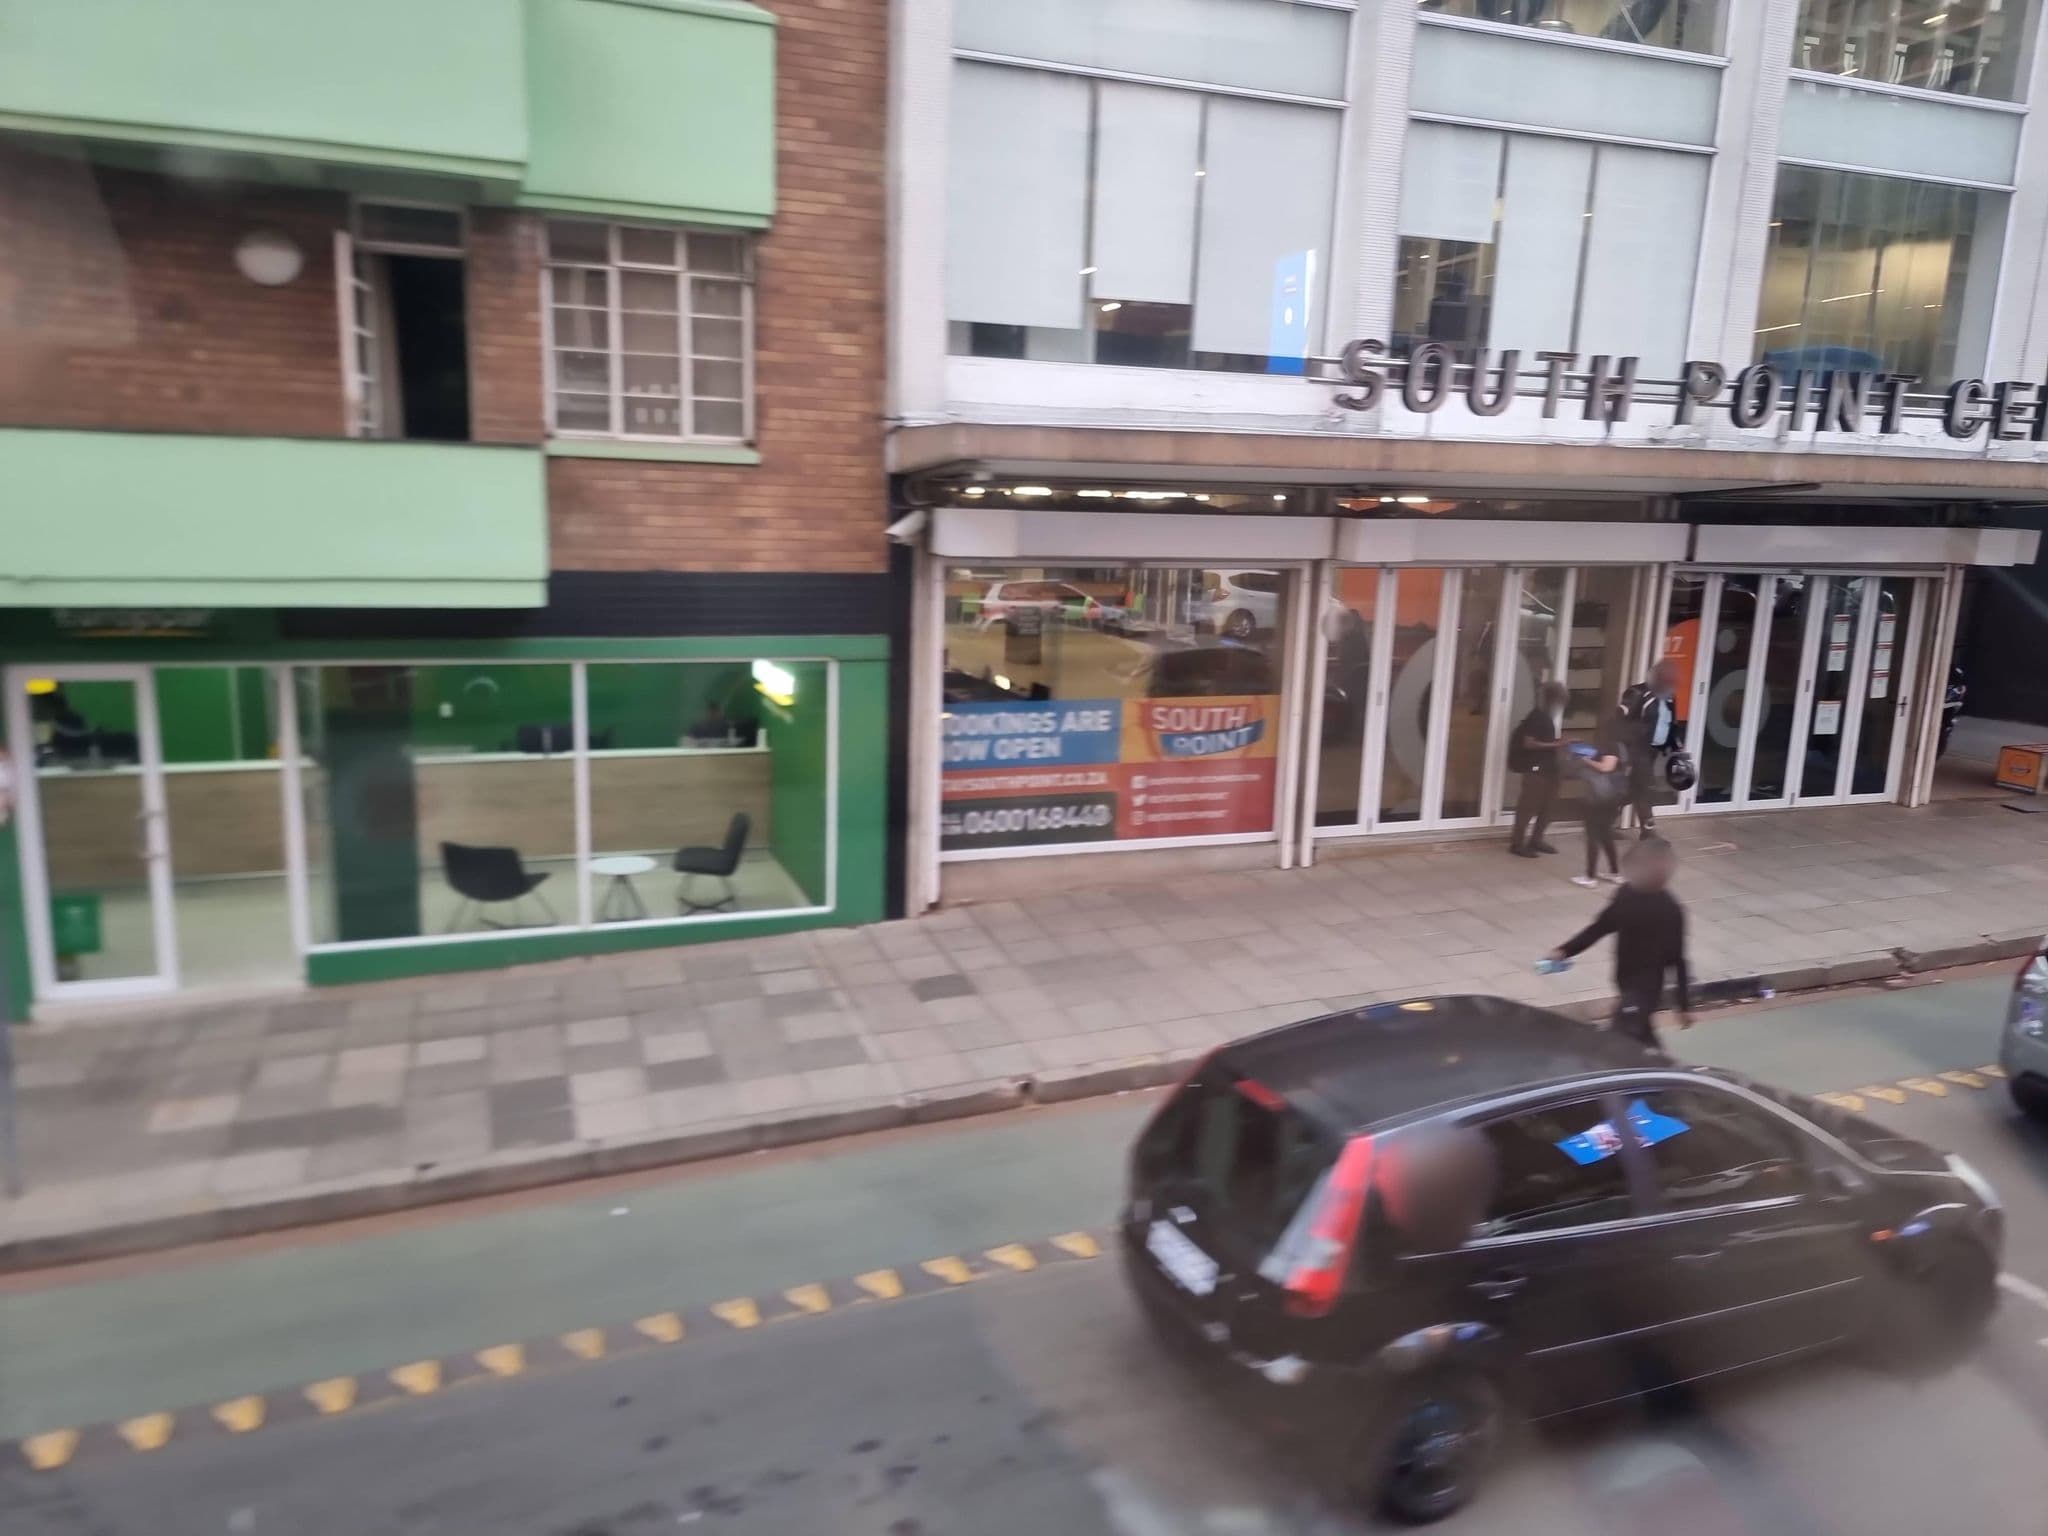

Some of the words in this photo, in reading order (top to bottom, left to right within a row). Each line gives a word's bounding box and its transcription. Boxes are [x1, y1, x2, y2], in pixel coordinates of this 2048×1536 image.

[1333, 338, 1639, 422] SOUTH
[1674, 361, 1921, 434] POINT
[1060, 710, 1113, 732] ARE
[1151, 706, 1248, 731] SOUTH
[994, 737, 1061, 759] OPEN
[1172, 727, 1252, 754] POINT
